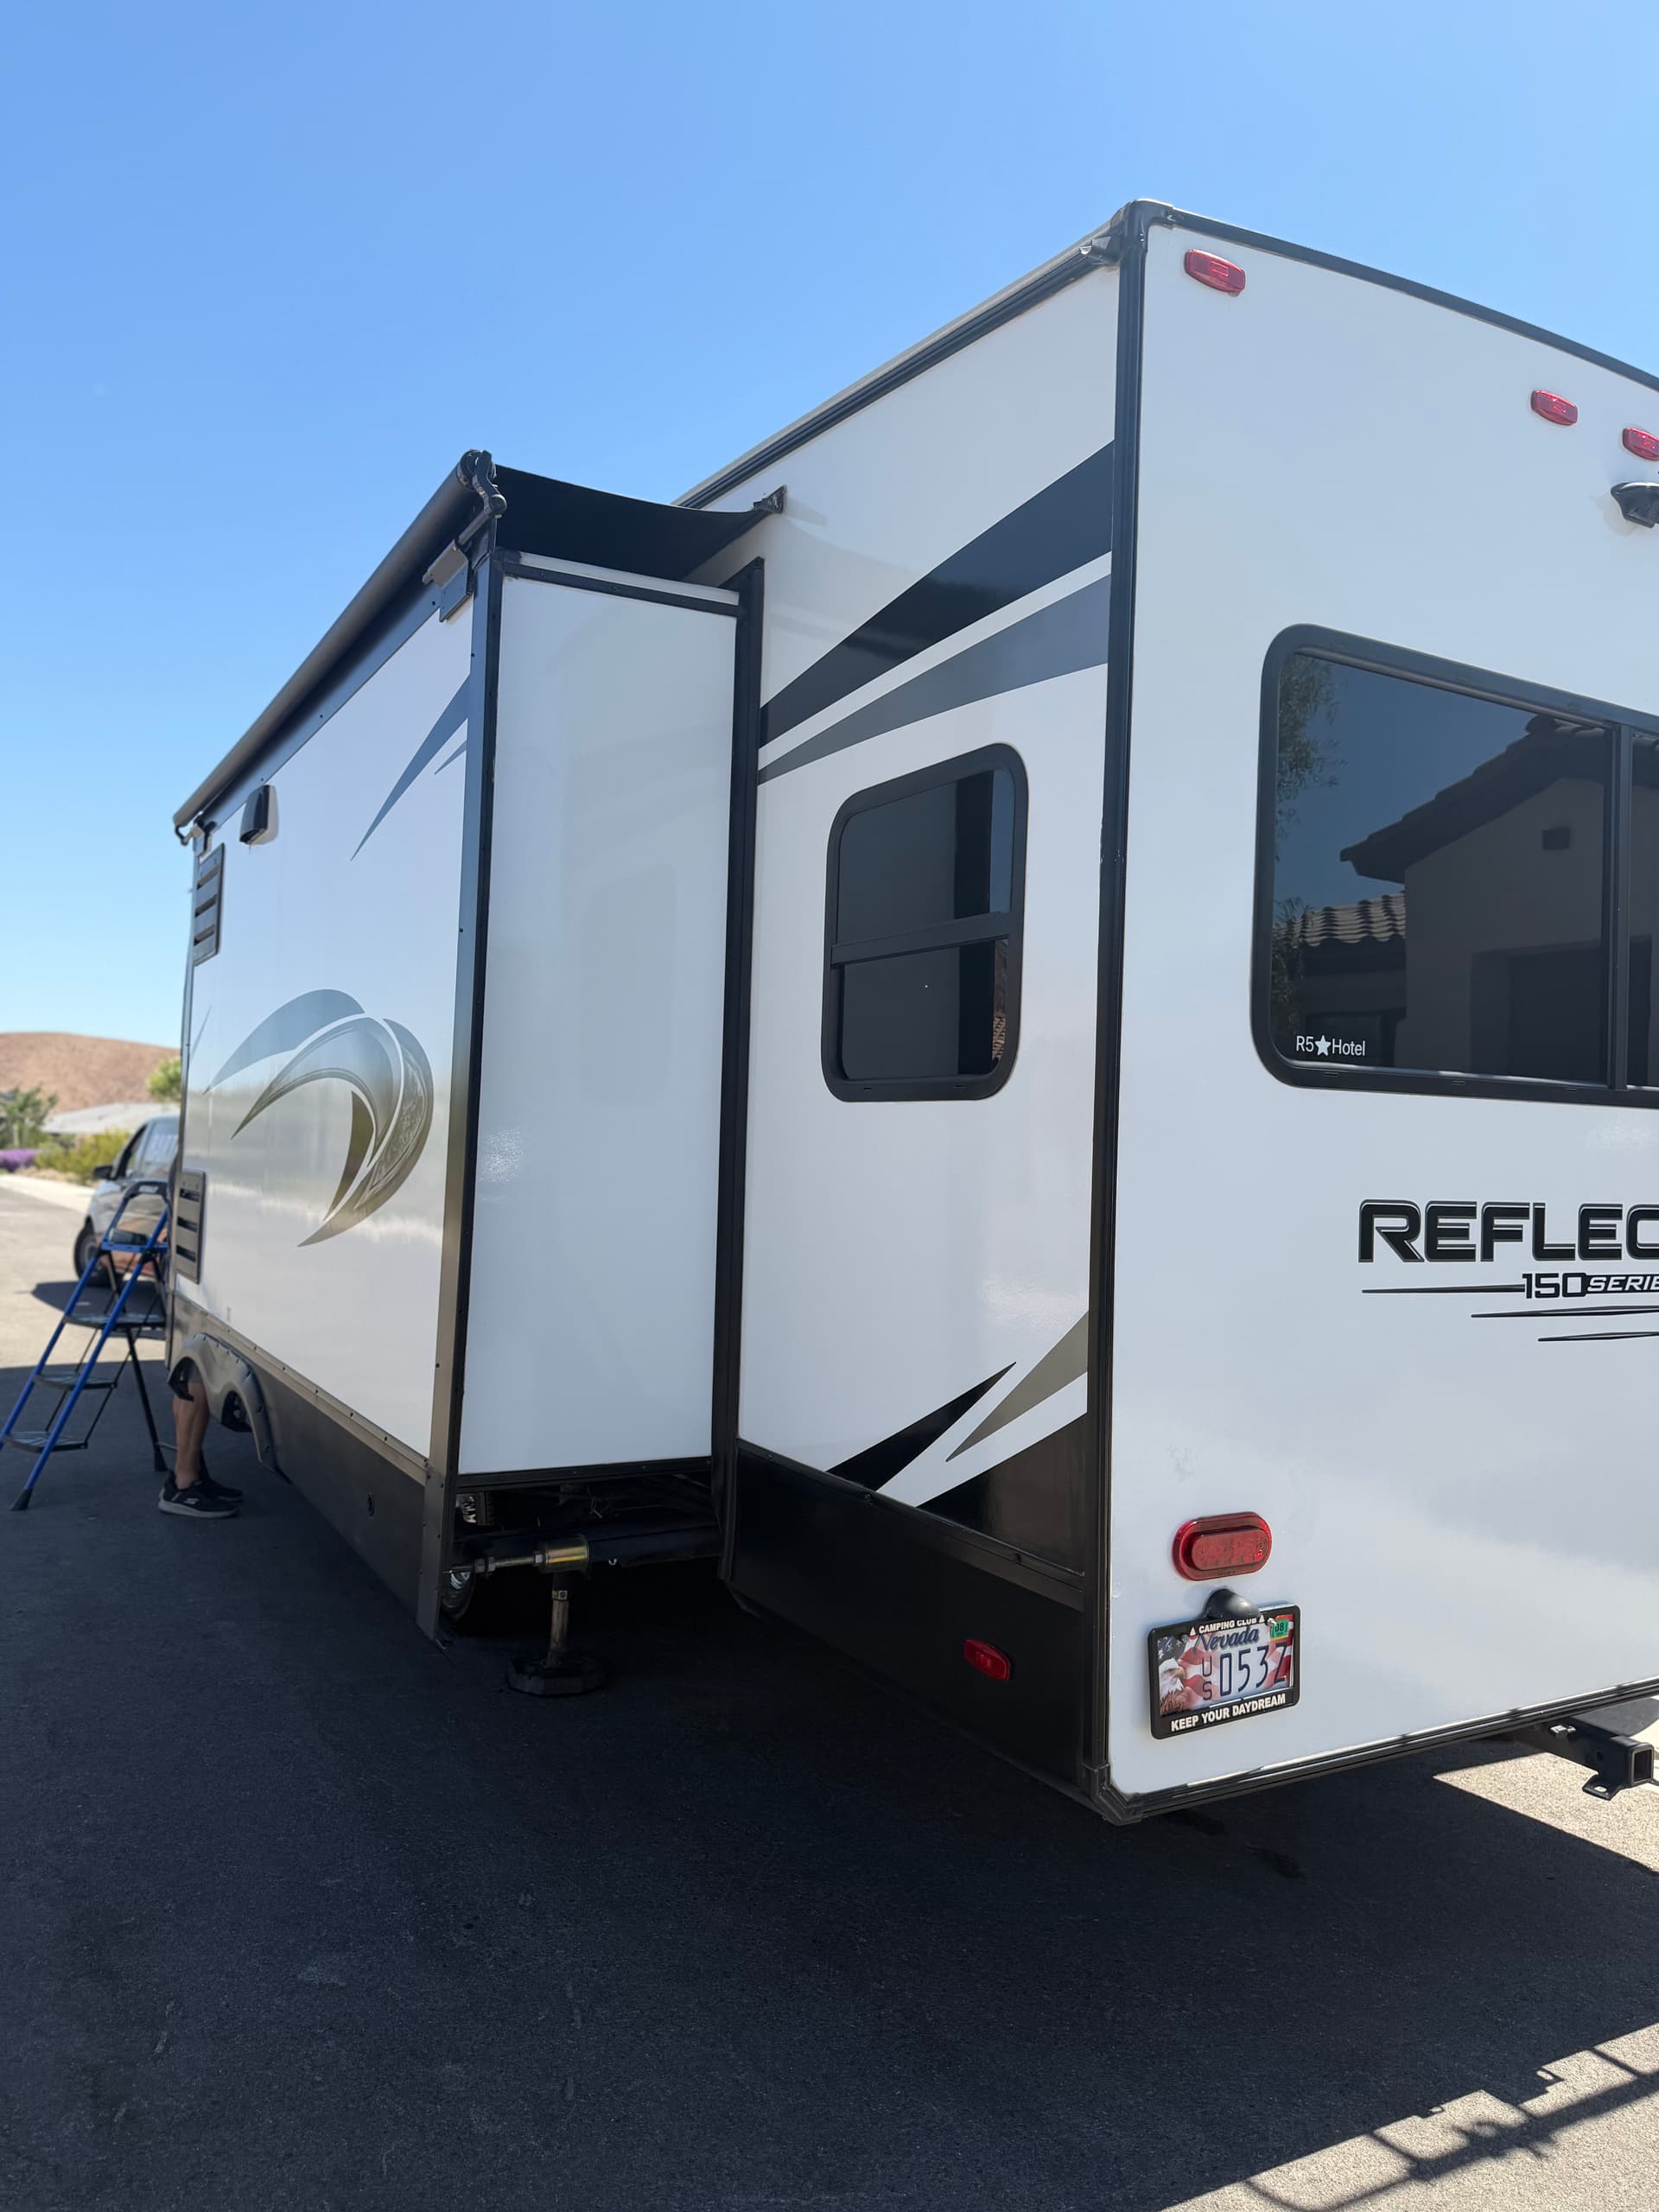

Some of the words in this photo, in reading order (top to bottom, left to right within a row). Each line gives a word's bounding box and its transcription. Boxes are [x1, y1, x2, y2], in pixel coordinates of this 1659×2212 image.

[1358, 1198, 1659, 1262] REFLEC
[1522, 1273, 1587, 1299] 150
[1198, 1619, 1236, 1634] CAMPING
[1236, 1617, 1257, 1626] CLUB
[1193, 1626, 1260, 1654] Nevada
[1171, 1714, 1199, 1732] KEEP
[1201, 1707, 1230, 1725] YOUR
[1232, 1694, 1287, 1717] DAYDREAM
